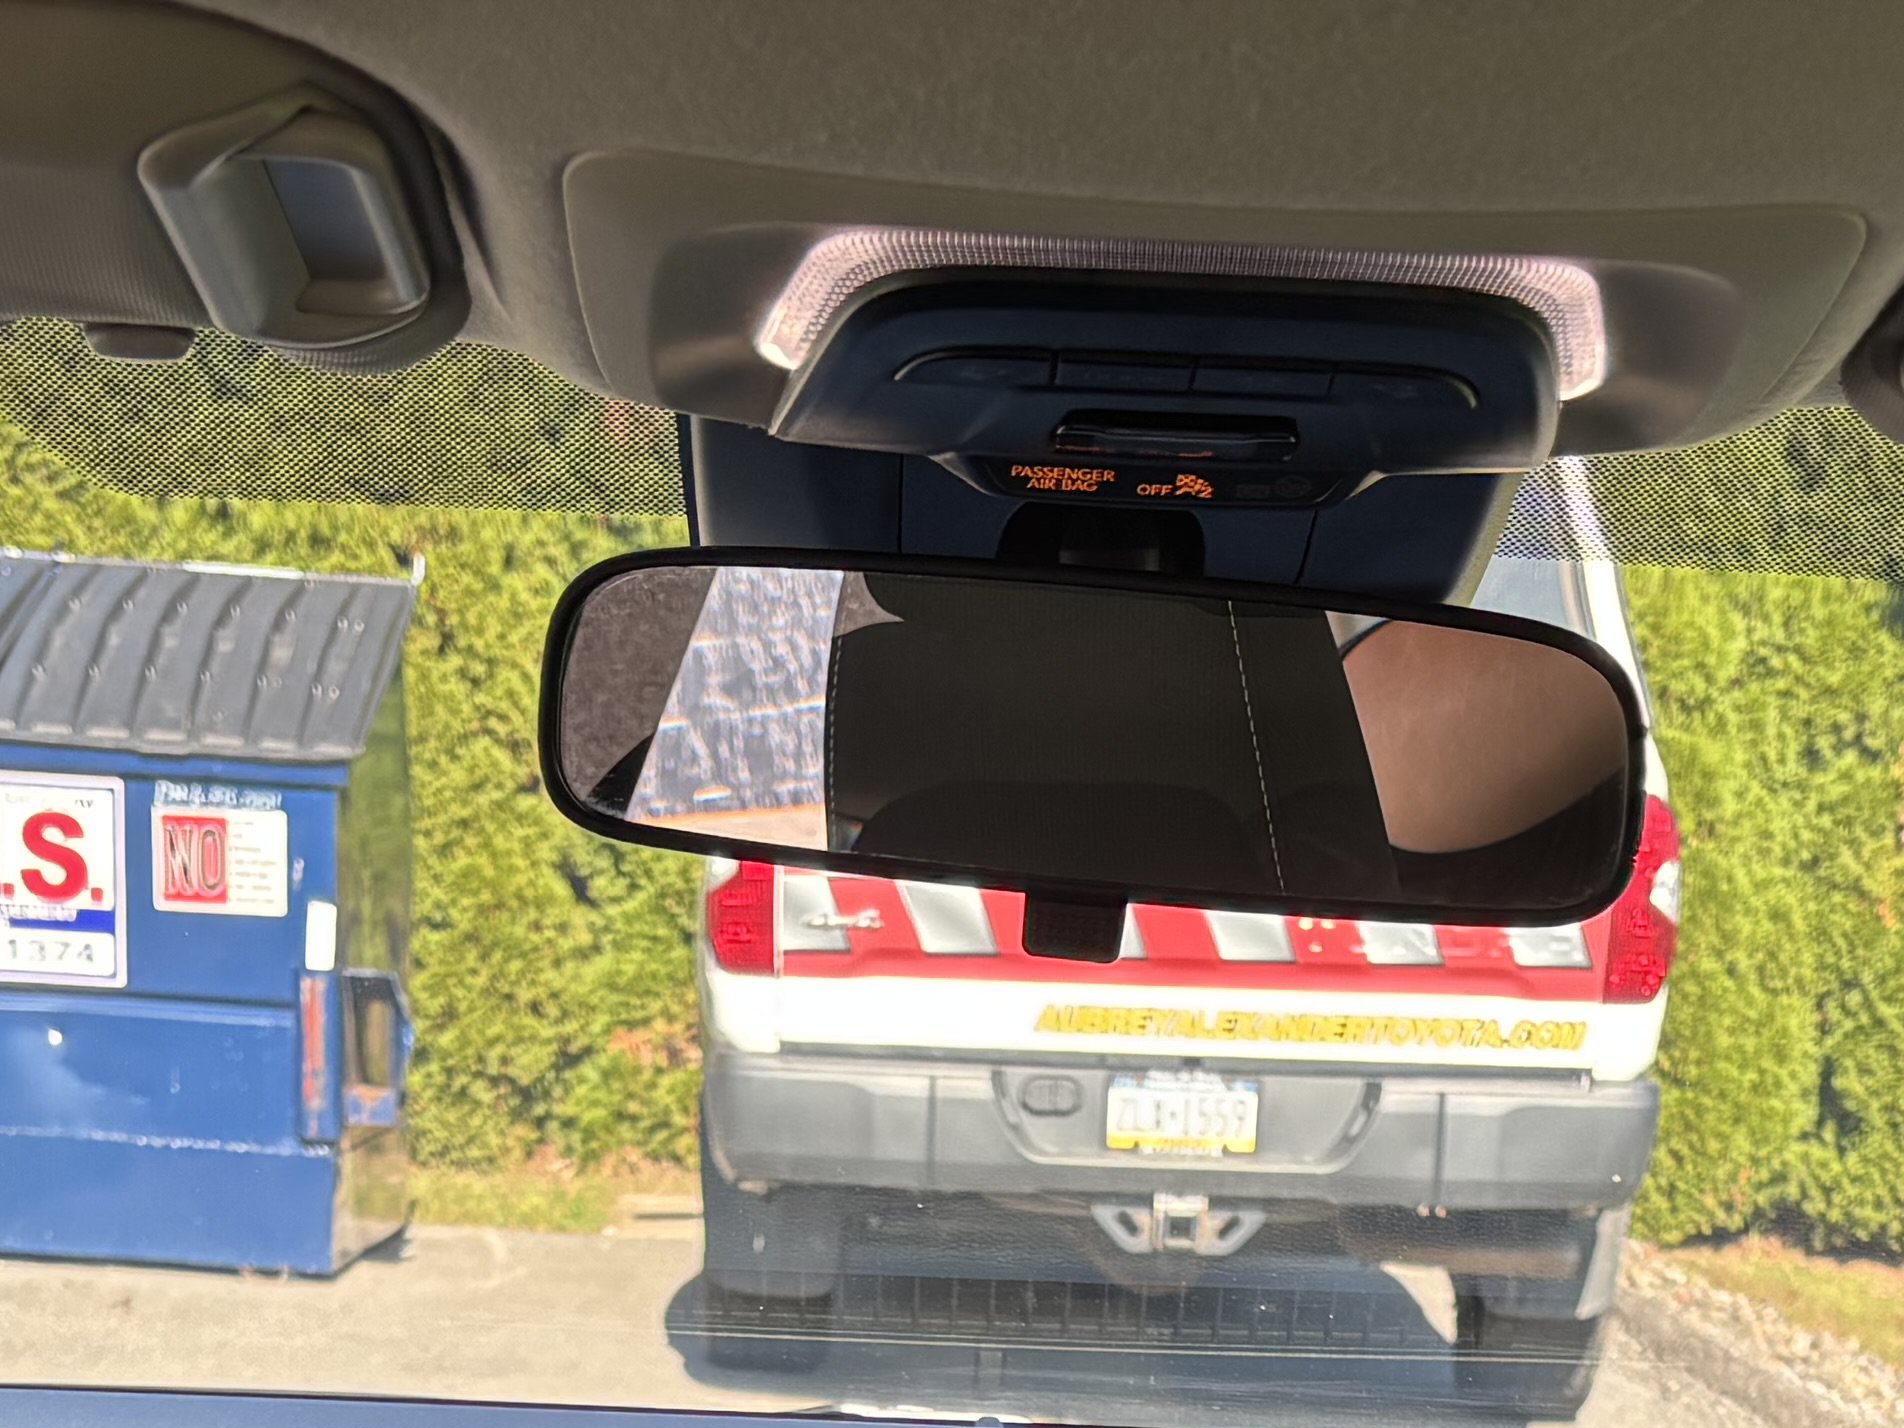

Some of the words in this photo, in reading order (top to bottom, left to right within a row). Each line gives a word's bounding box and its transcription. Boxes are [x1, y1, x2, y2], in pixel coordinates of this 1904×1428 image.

[1011, 465, 1115, 482] PASSENGER
[1027, 478, 1057, 490] AIR
[1062, 480, 1098, 491] BAG
[1137, 484, 1173, 496] OFF
[164, 823, 223, 896] NO
